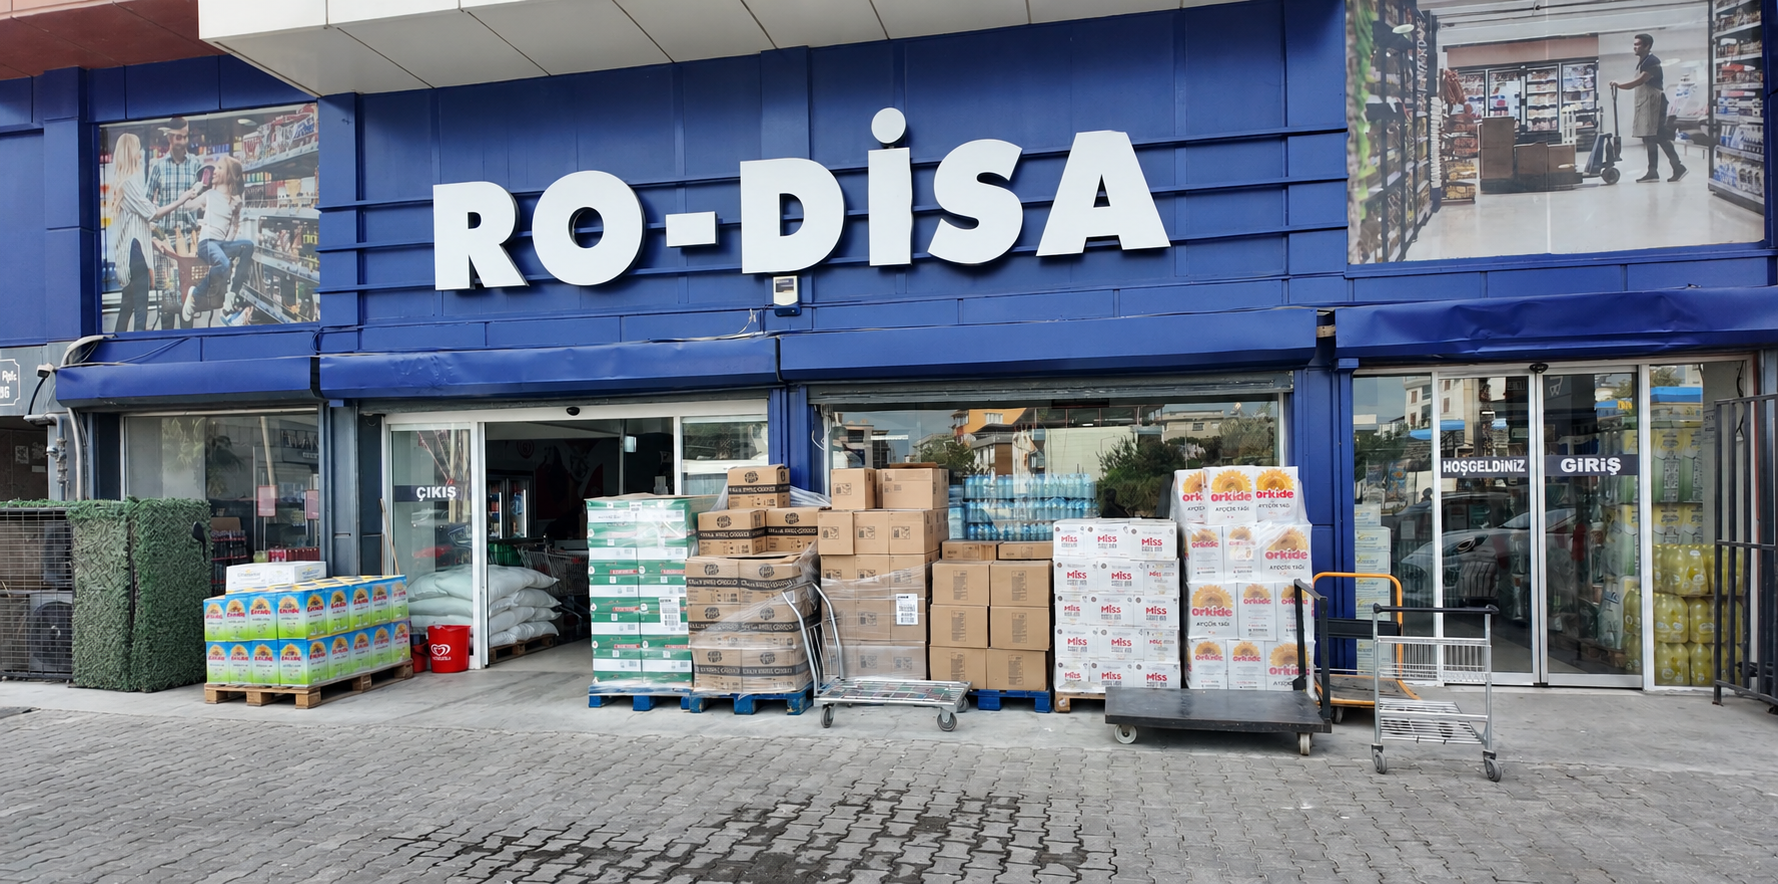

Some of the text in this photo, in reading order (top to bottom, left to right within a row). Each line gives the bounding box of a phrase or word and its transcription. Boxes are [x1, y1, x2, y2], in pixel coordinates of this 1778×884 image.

[1560, 457, 1621, 476] GİRİŞ
[416, 486, 457, 502] ÇIKIŞ
[1255, 487, 1294, 499] orkide
[1097, 534, 1117, 543] Miss
[1141, 537, 1163, 546] Miss
[1066, 570, 1087, 579] Miss
[1111, 570, 1132, 580] Miss
[1101, 604, 1122, 614] Miss
[1145, 605, 1167, 615] Miss
[1067, 637, 1088, 646] Miss
[1111, 637, 1132, 647] Miss
[1101, 671, 1122, 680] Miss
[1146, 672, 1168, 681] Miss
